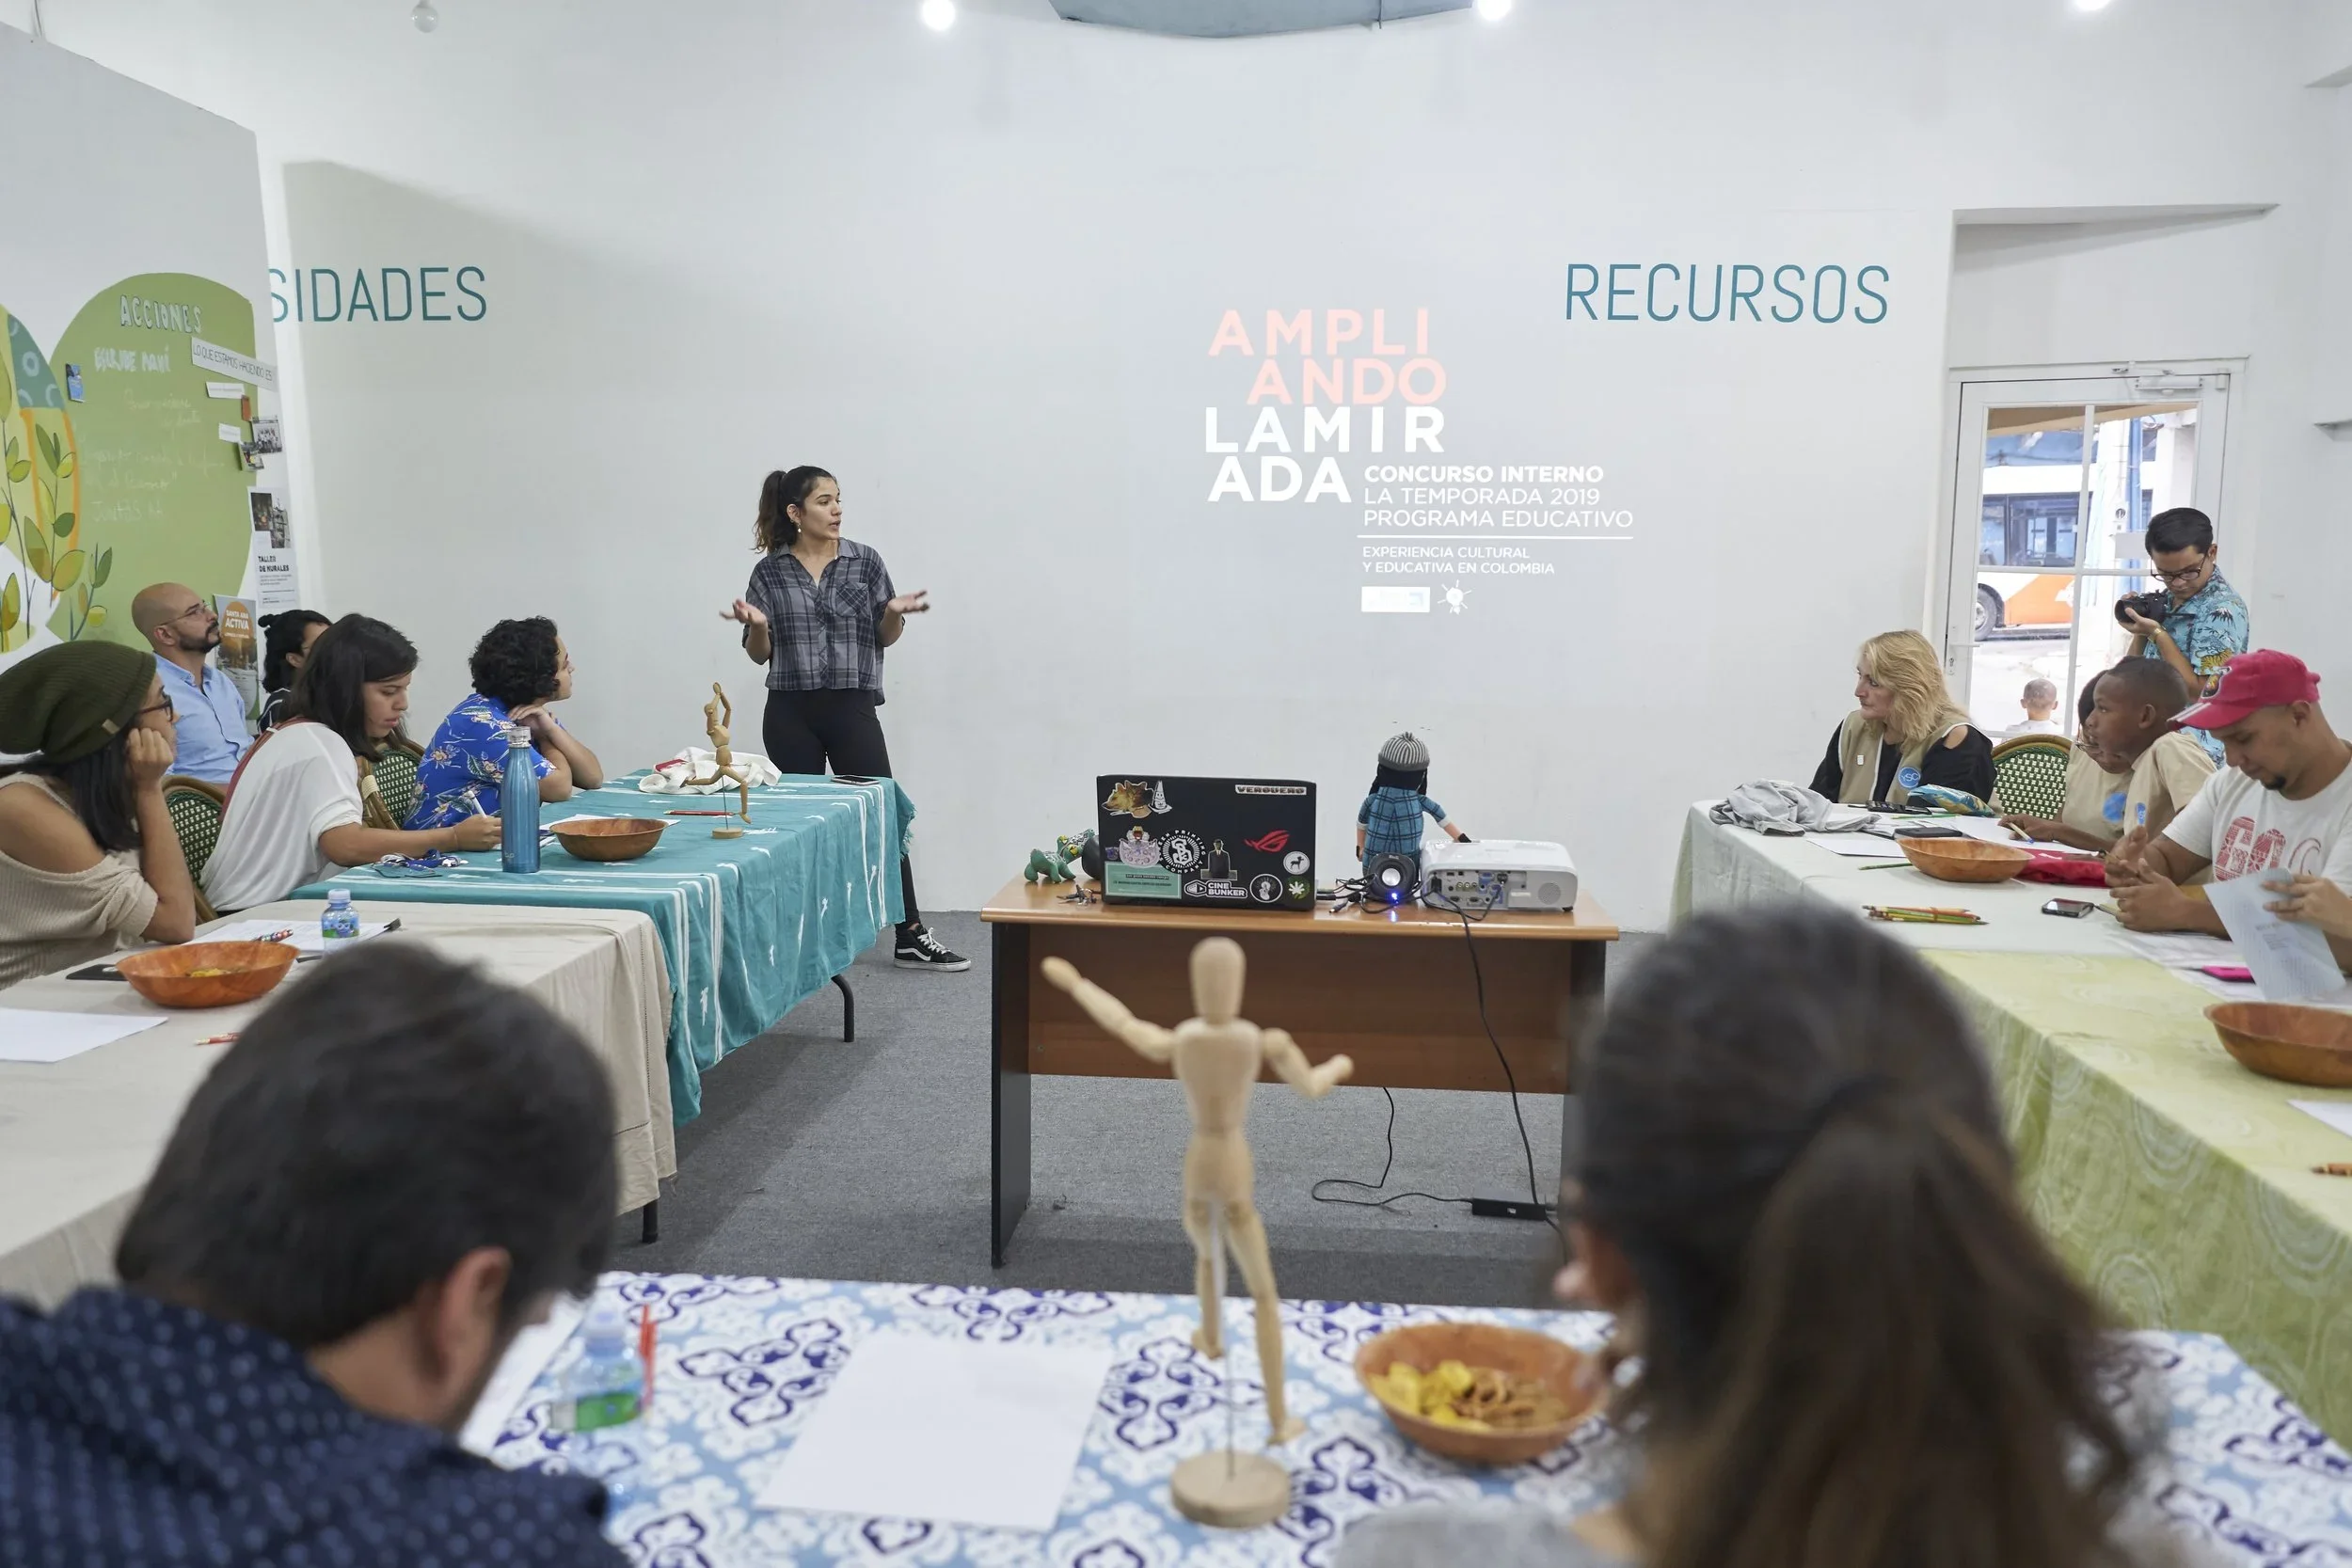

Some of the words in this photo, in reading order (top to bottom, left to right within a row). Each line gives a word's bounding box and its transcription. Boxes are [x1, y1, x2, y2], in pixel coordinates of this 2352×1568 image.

[268, 266, 486, 323] SIDADES
[1566, 263, 1889, 324] RECURSOS
[120, 294, 202, 333] ACCIONES
[1208, 309, 1428, 356] AMPLI
[1247, 357, 1447, 404] ANDO
[1205, 405, 1445, 452] LAMIR
[1207, 455, 1352, 502] ADA
[1364, 465, 1494, 483] CONCURSO
[1501, 465, 1604, 483] INTERNO
[1364, 487, 1393, 505] LA
[1401, 487, 1543, 506] TEMPORADA
[1550, 487, 1601, 506] 2019
[1363, 509, 1495, 528] PROGRAMA
[1502, 509, 1634, 529] EDUCATIVO
[1362, 546, 1454, 558] EXPERIENCIA
[1457, 546, 1530, 559] CULTURAL
[1362, 562, 1372, 573] Y
[1375, 562, 1454, 574] EDUCATIVA
[1458, 562, 1479, 574] EN
[1480, 562, 1555, 575] COLOMBIA
[225, 617, 250, 630] ACTIVA
[1175, 830, 1206, 856] PRINTING
[1166, 860, 1203, 874] COMPANY
[1208, 889, 1246, 897] BUNKER
